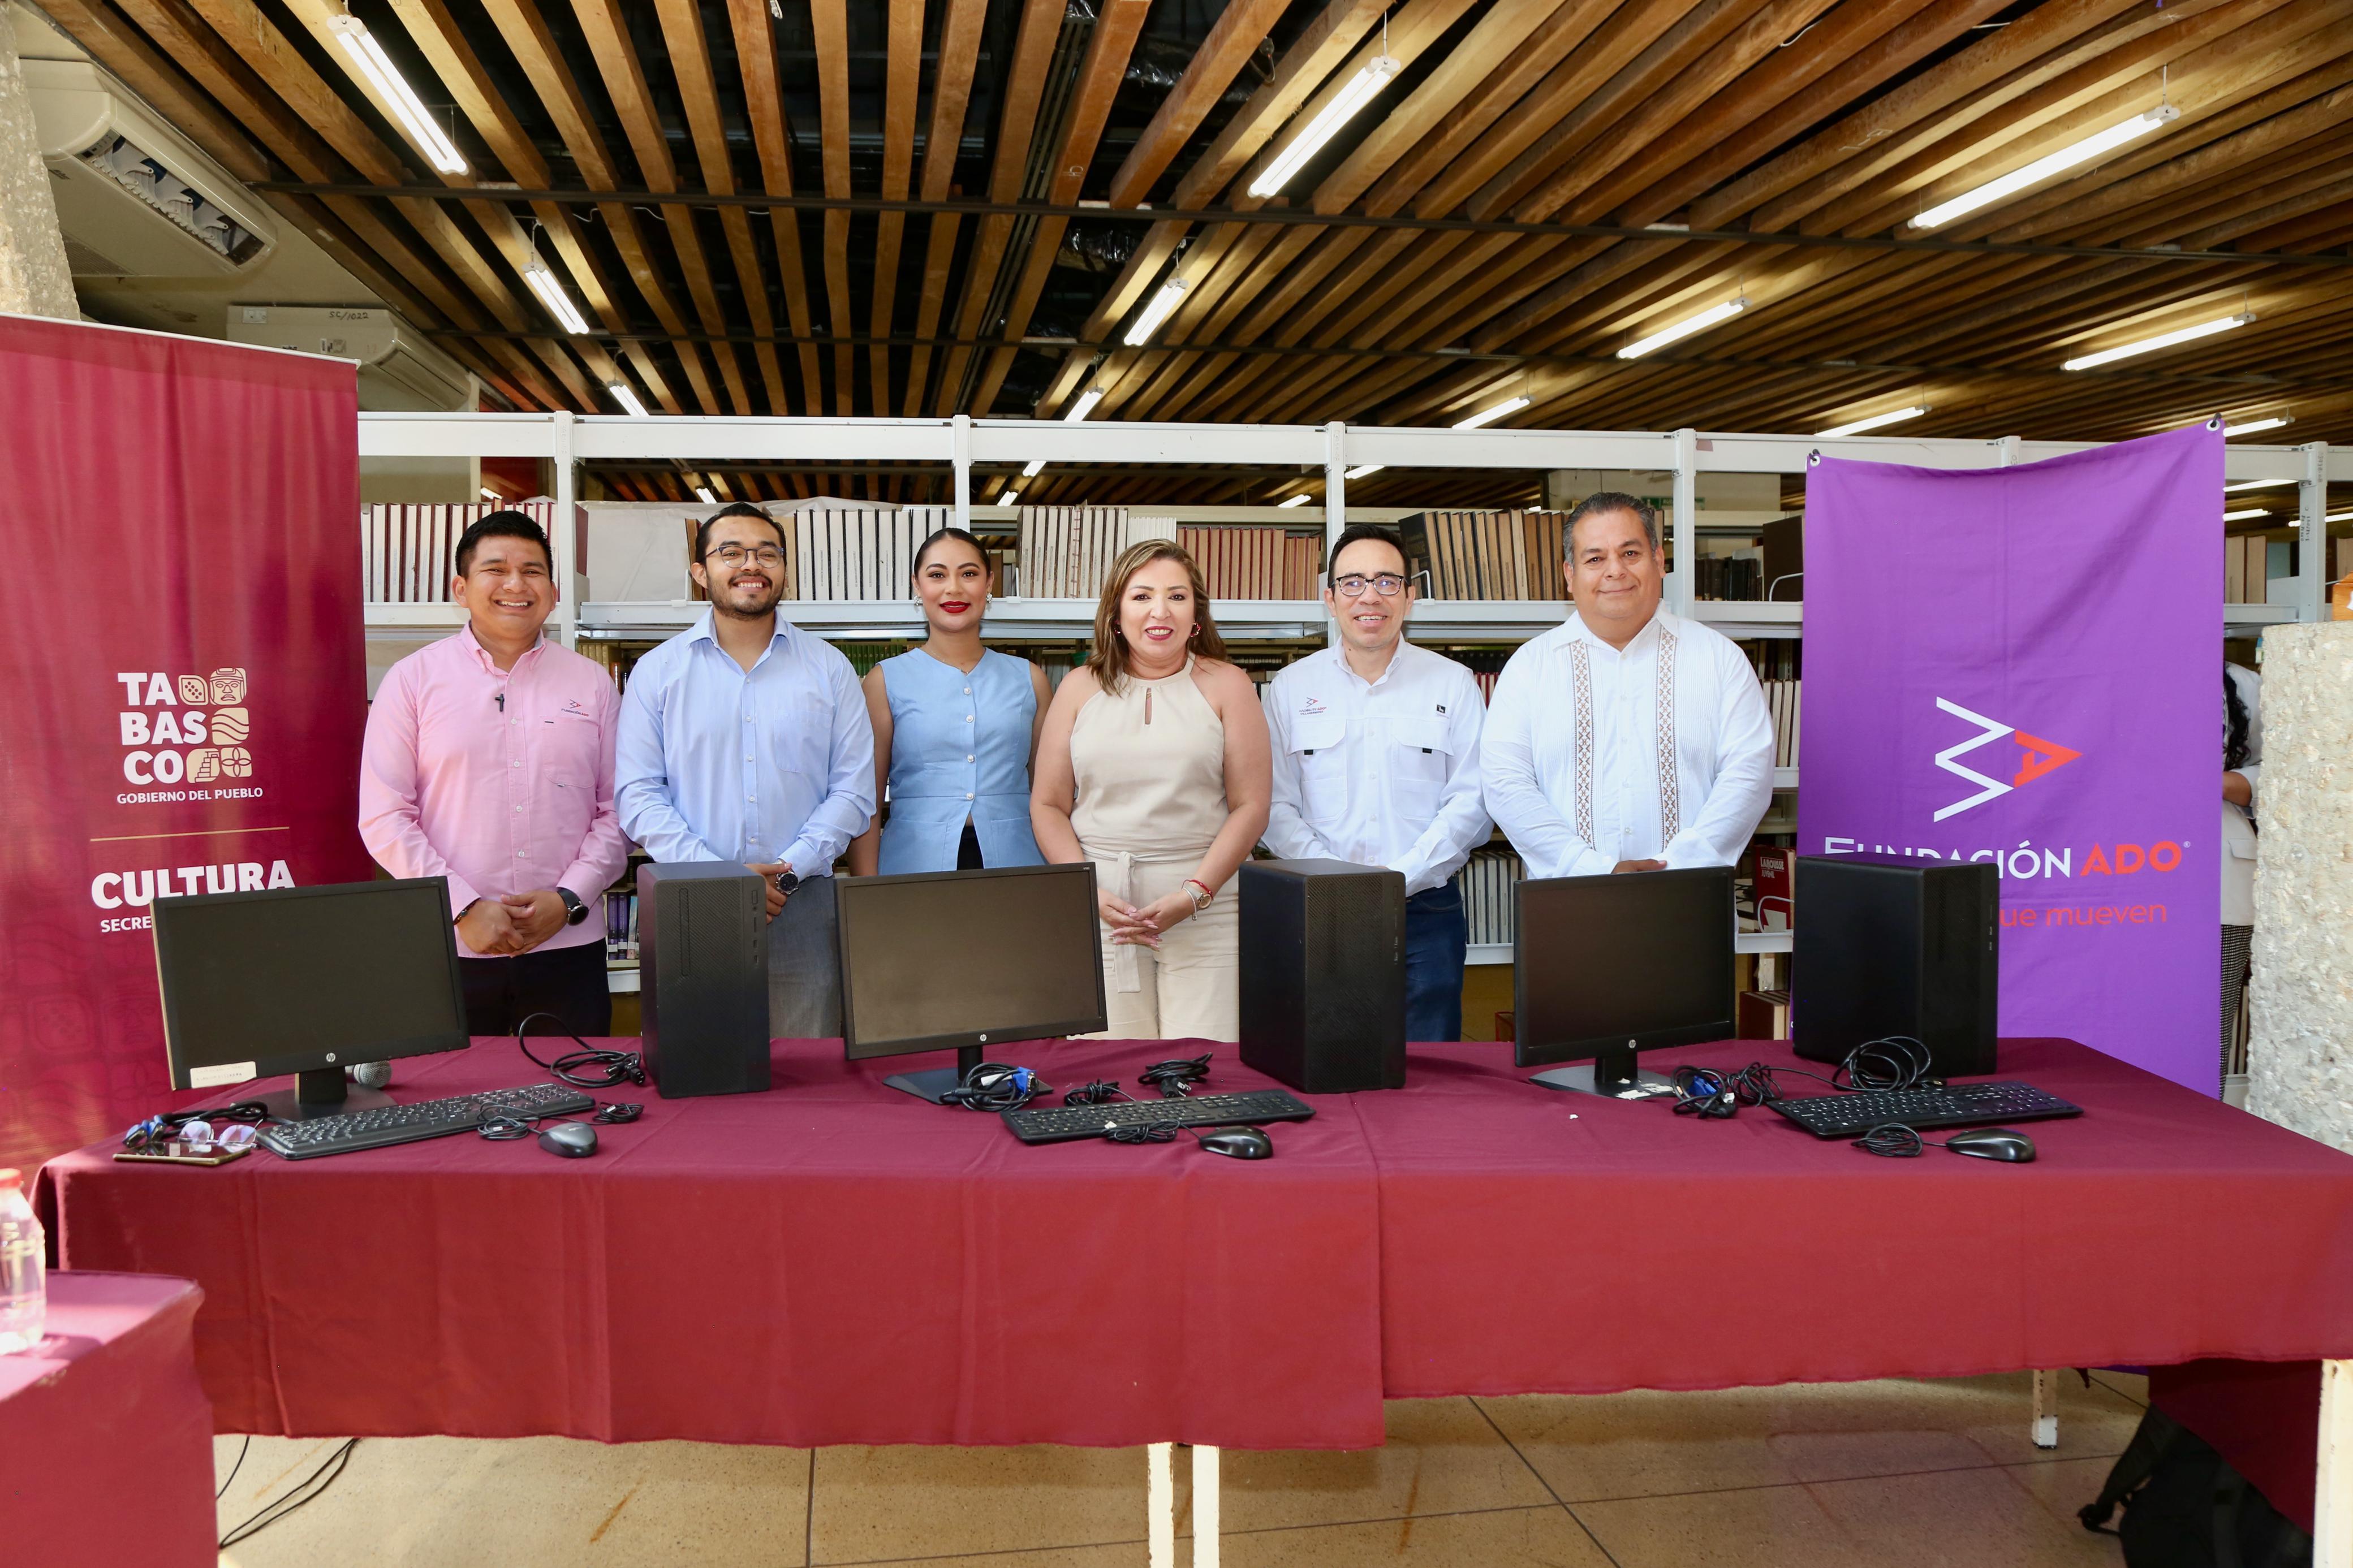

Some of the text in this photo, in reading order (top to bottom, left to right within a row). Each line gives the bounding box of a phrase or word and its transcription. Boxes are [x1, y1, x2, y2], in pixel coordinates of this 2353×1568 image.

[117, 672, 178, 706] TA
[120, 711, 207, 746] BAS
[123, 750, 184, 785] CO
[117, 787, 264, 804] GOBIERNO DEL PUEBLO
[91, 859, 296, 909] CULTURA
[100, 915, 153, 932] SECRE
[2046, 904, 2166, 927] mueven
